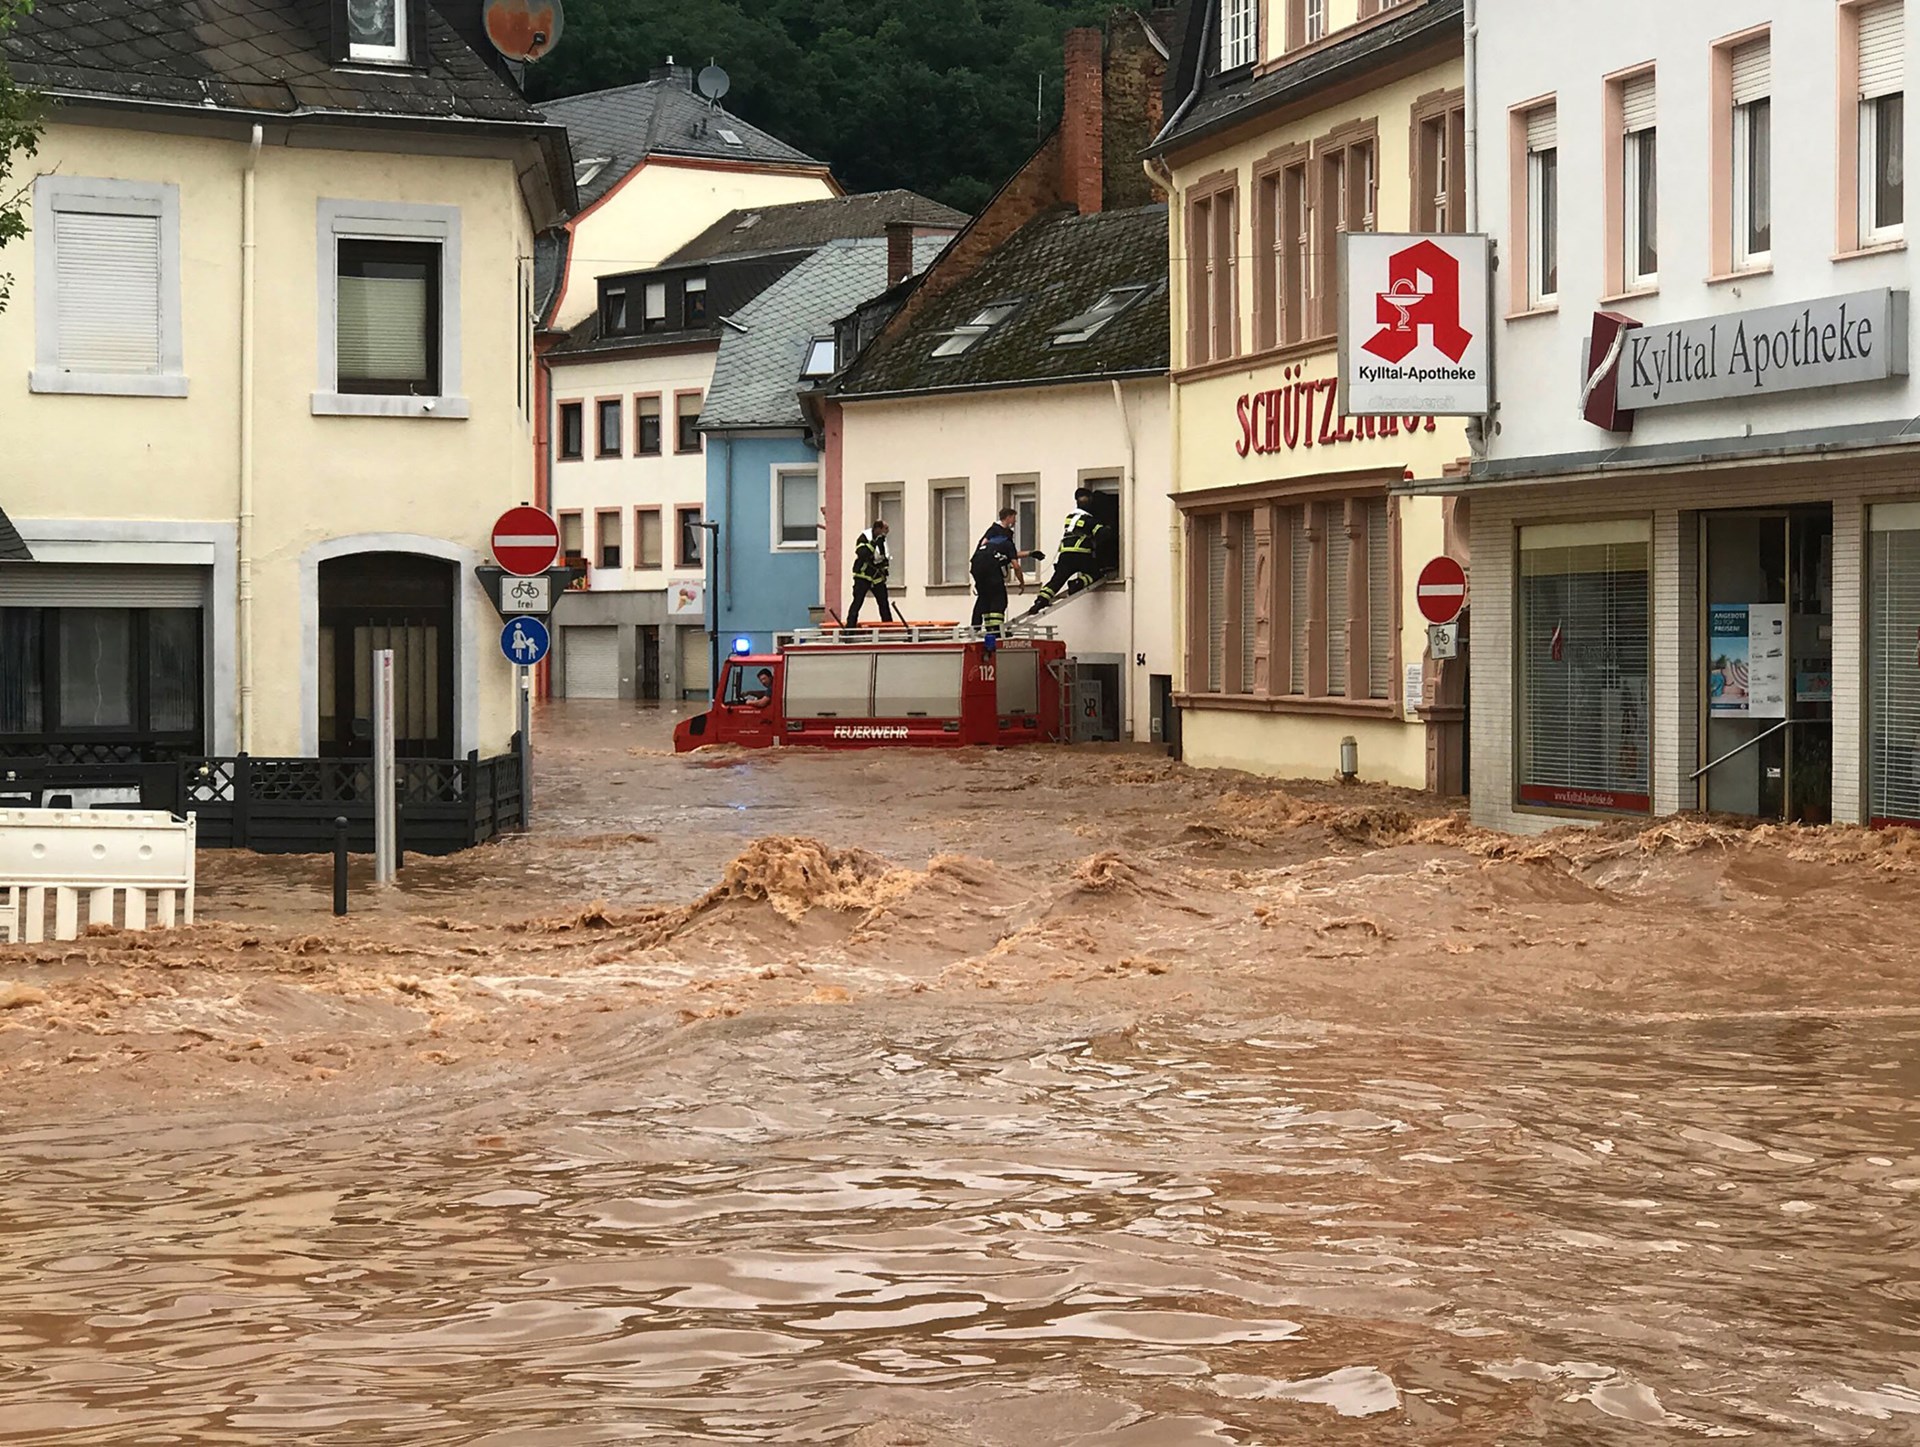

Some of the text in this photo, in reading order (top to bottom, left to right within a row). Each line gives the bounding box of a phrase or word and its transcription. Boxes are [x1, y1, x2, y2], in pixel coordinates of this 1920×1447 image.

[1630, 303, 1873, 400] Kylltal Apotheke
[1359, 365, 1476, 382] Kylltal-Apotheke
[1235, 364, 1436, 459] SCHÜTZ
[517, 600, 534, 609] frei
[1002, 640, 1033, 648] FEUERWEHR
[1136, 652, 1146, 666] 54
[979, 664, 995, 681] 112
[833, 725, 909, 739] FEUERWEHR
